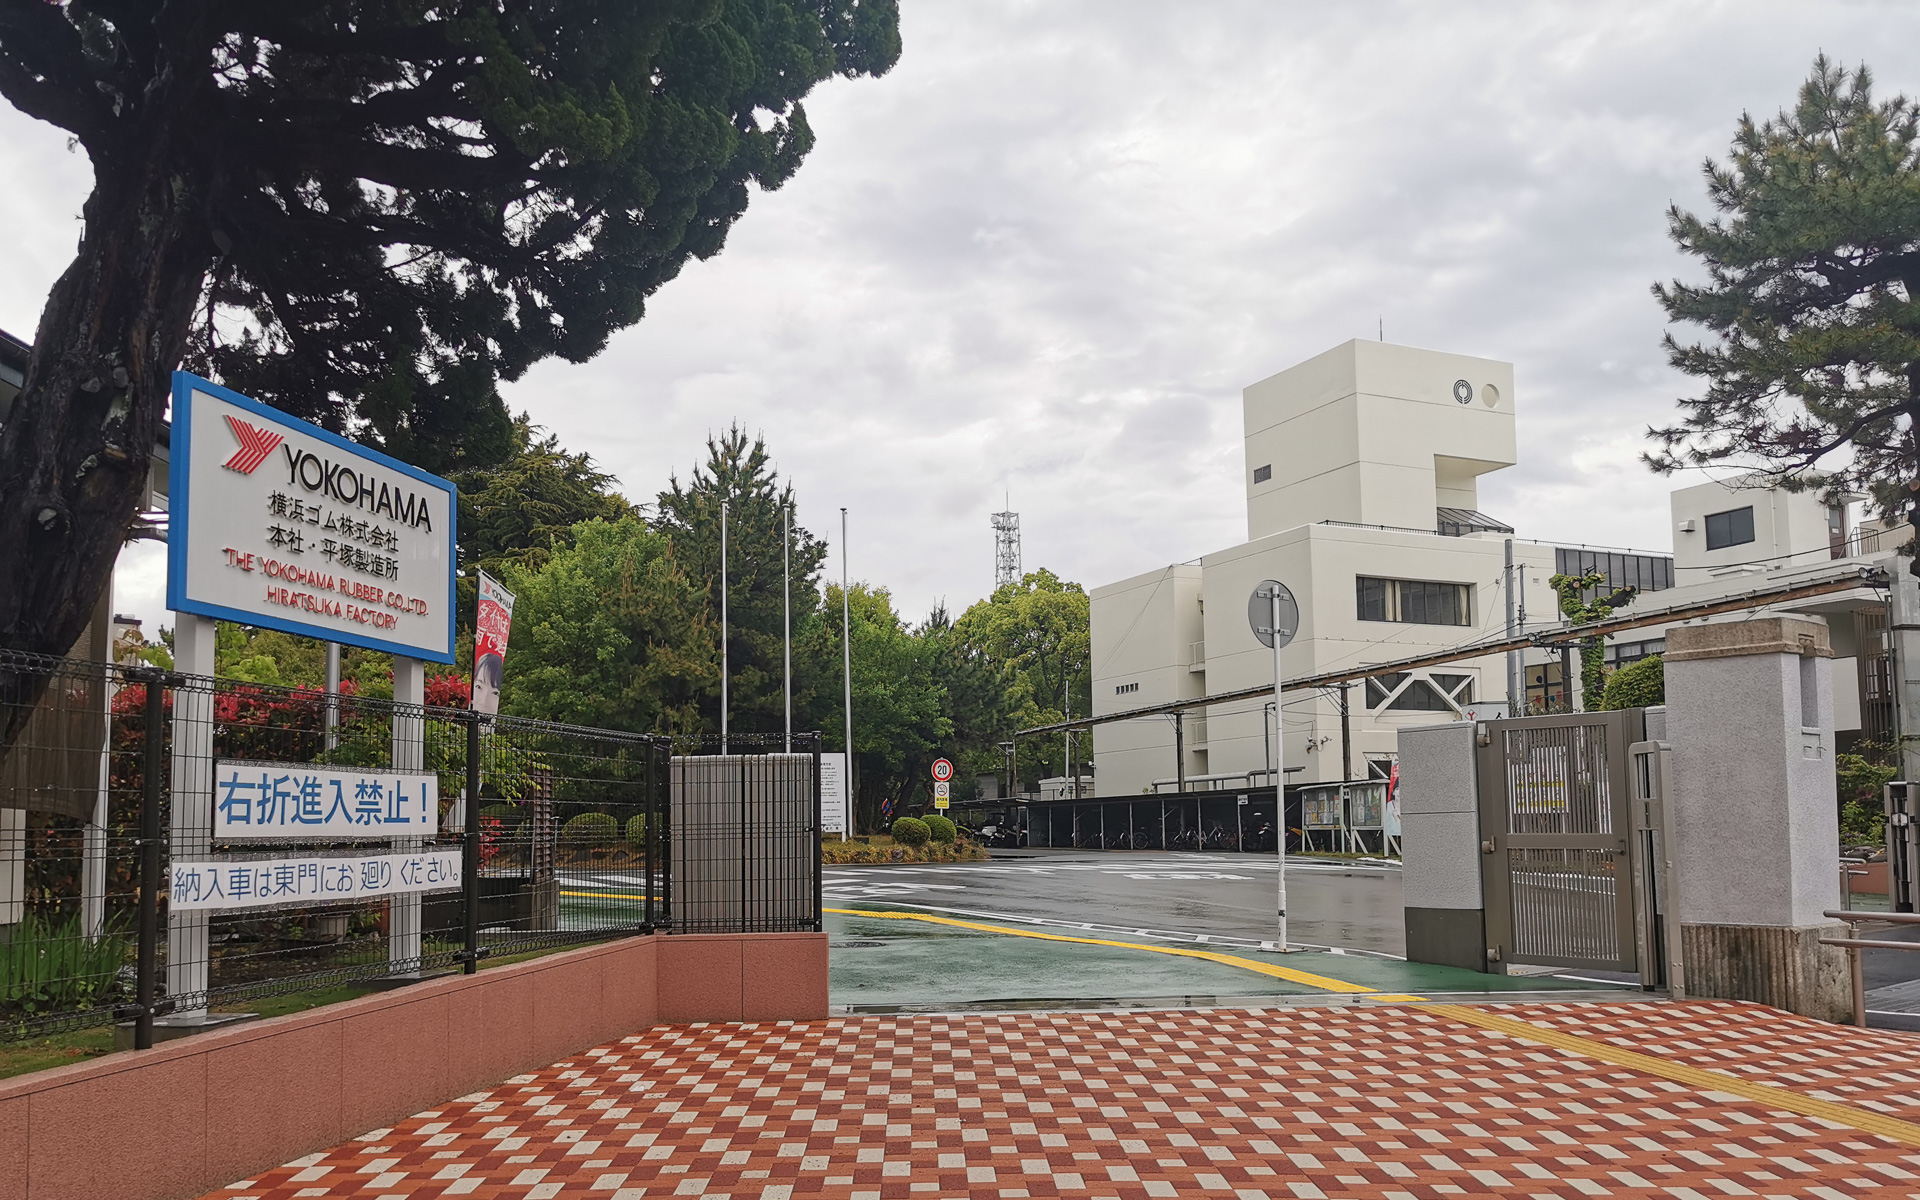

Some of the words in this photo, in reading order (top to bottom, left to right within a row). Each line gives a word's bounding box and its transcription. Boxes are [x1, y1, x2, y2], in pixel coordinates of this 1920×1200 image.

[284, 443, 432, 533] YOKOHAMA
[269, 490, 399, 552] 横浜ゴム株式会社
[269, 522, 399, 581] 本社・平塚製造所
[225, 547, 255, 571] THE
[260, 556, 335, 591] YOKOHAMA
[339, 577, 384, 604] RUBBER
[387, 591, 429, 616] CO.,LTD.
[267, 585, 343, 617] HIRATSUKA
[346, 604, 399, 630] FACTORY
[218, 771, 428, 826] 右折進入禁止！
[937, 765, 947, 775] 20
